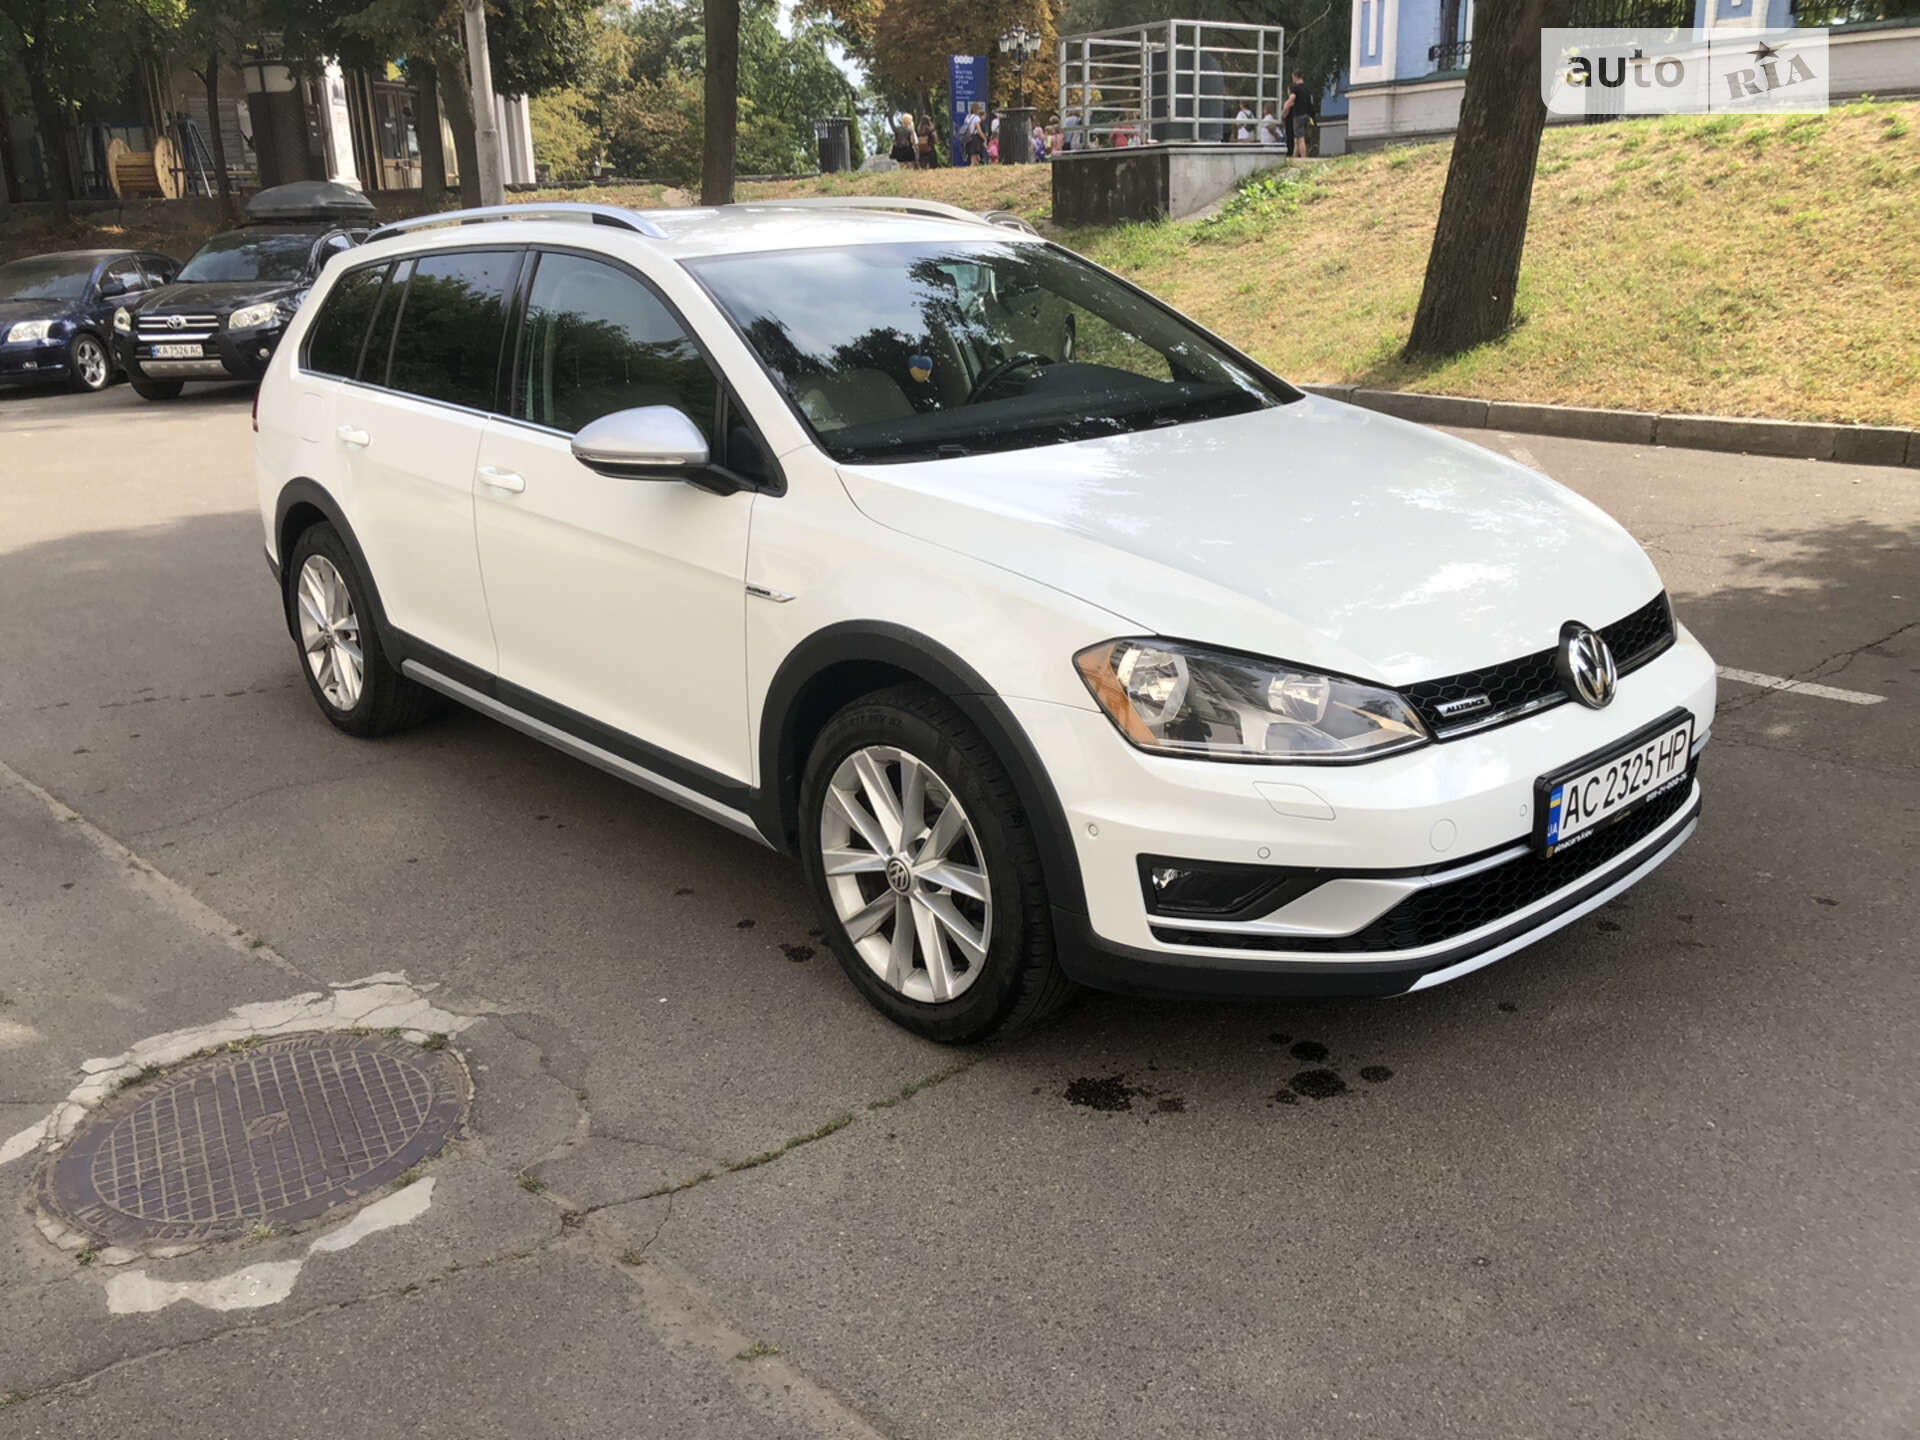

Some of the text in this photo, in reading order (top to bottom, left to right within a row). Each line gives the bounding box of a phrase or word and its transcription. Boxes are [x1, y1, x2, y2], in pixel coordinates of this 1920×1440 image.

[1563, 776, 1600, 830] AC
[1603, 745, 1655, 809] 2325
[1656, 729, 1687, 779] HP
